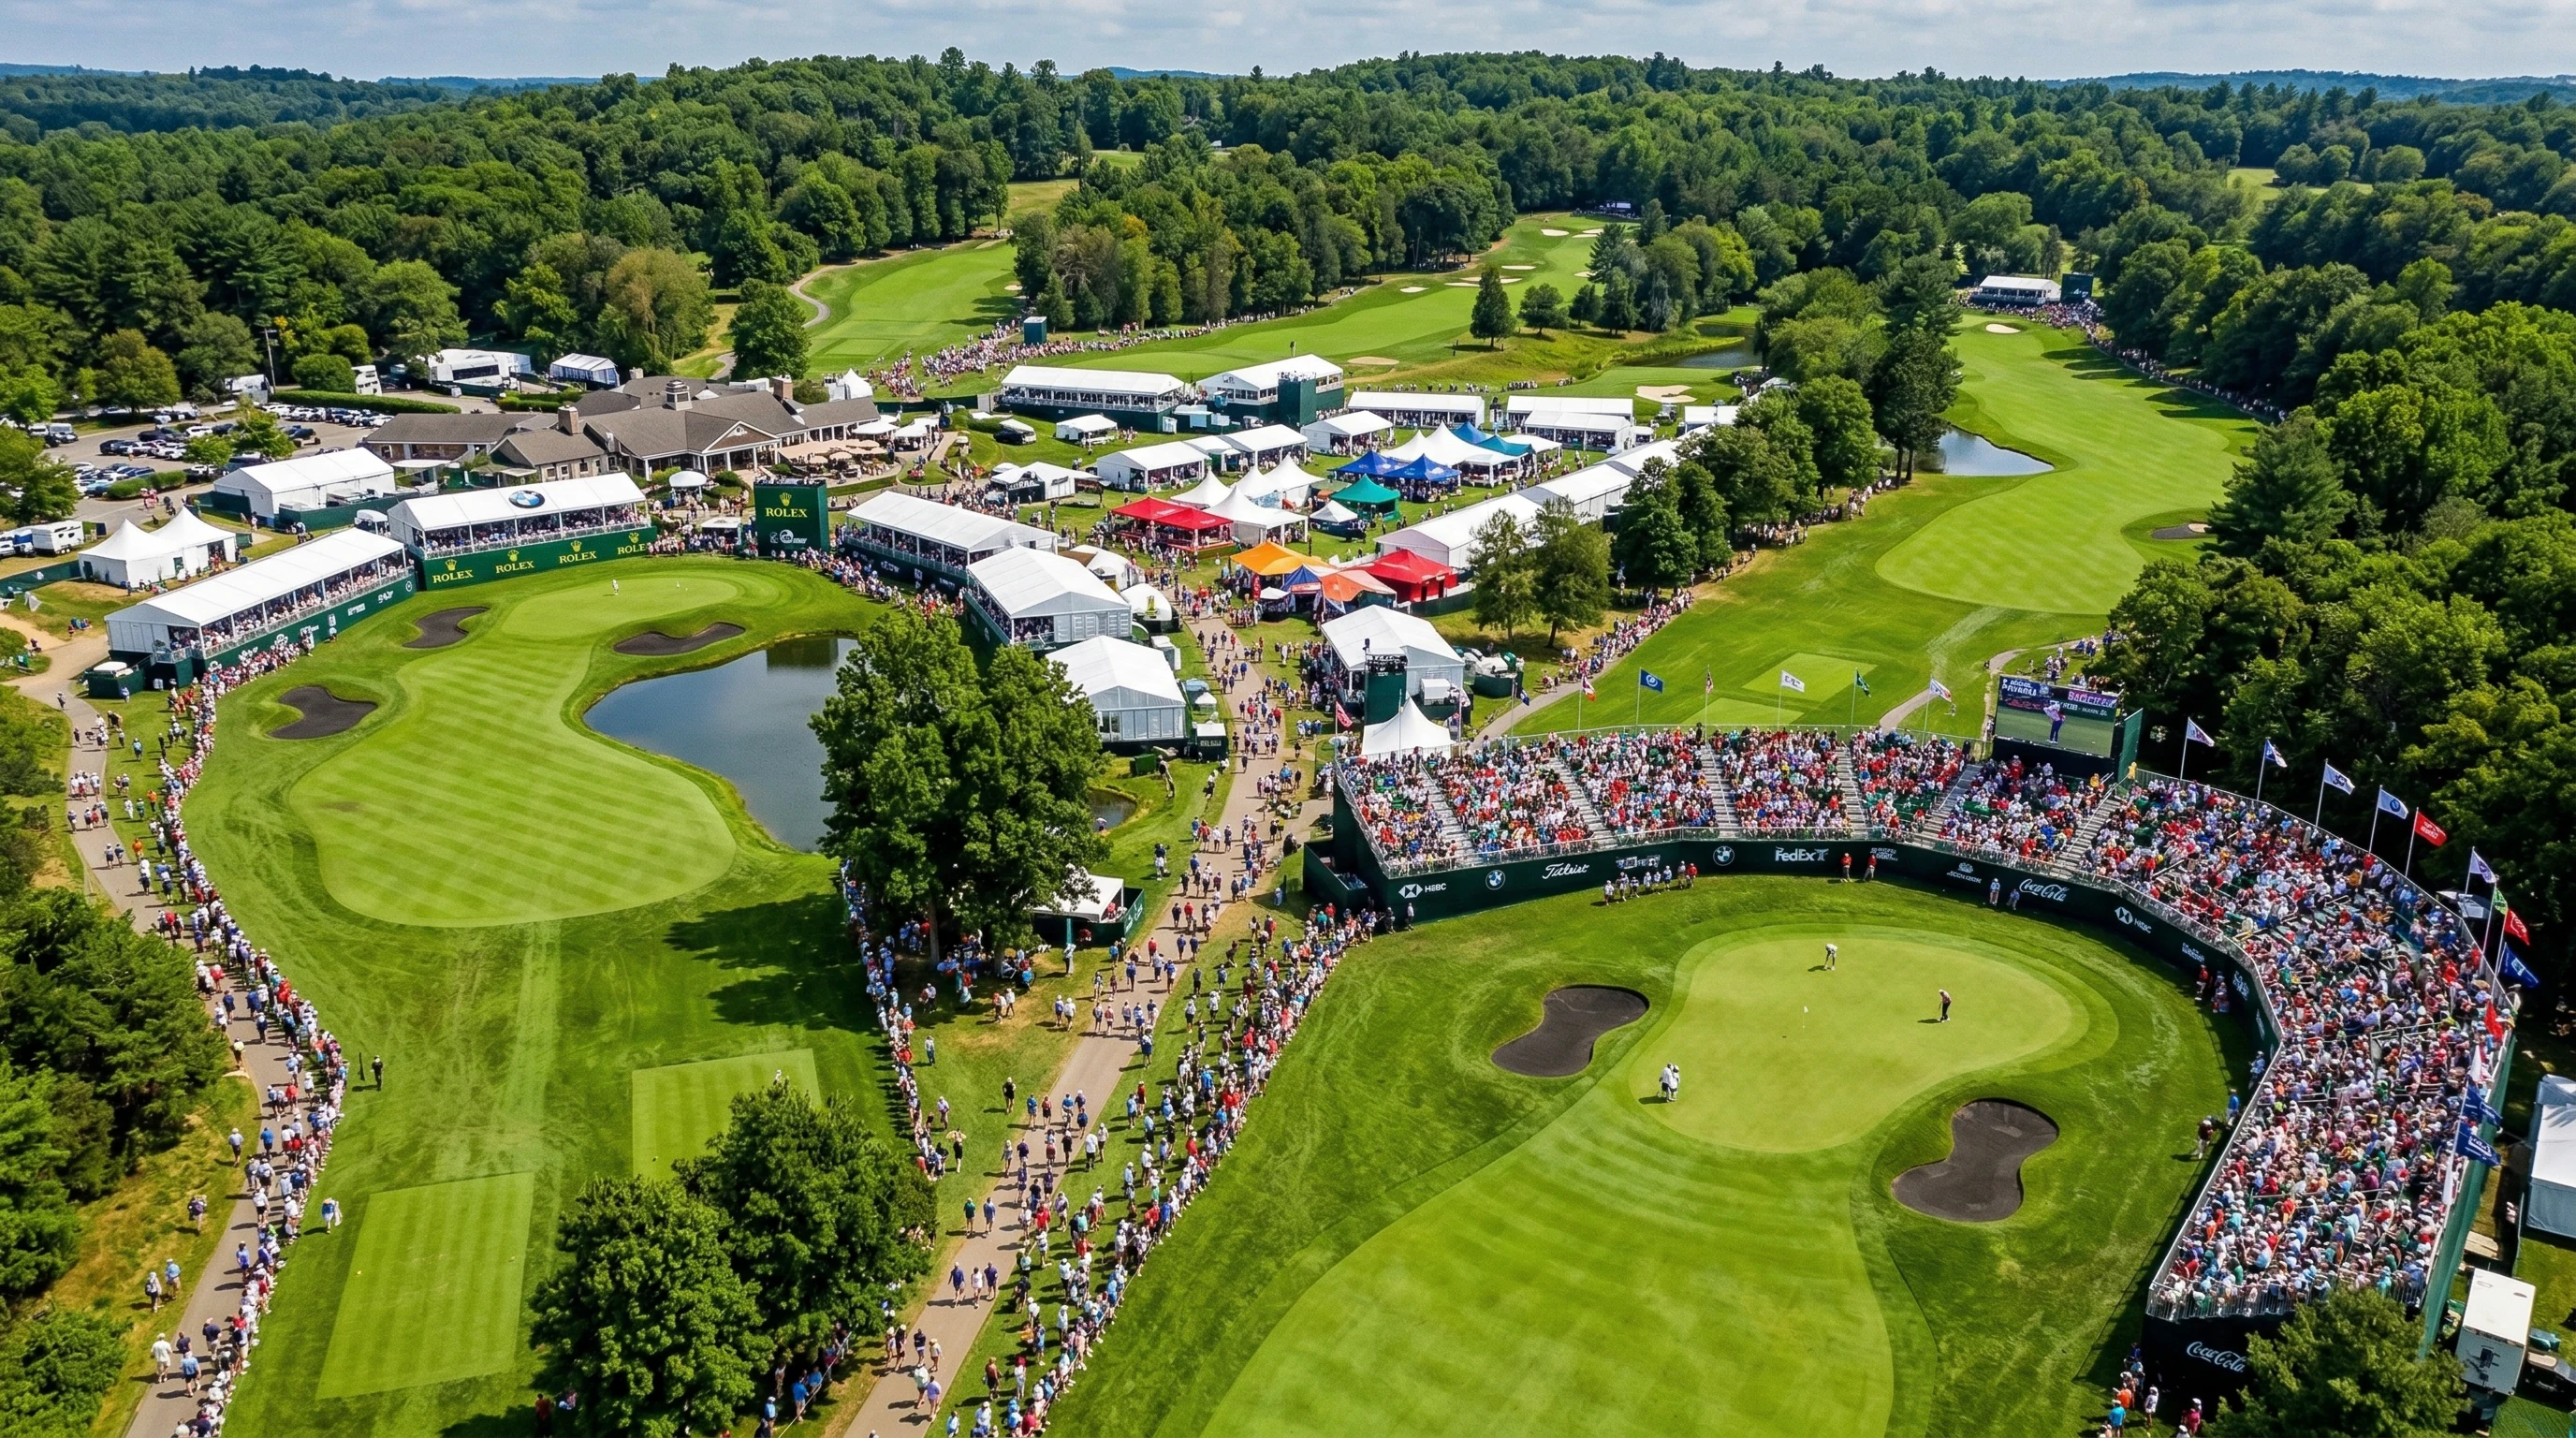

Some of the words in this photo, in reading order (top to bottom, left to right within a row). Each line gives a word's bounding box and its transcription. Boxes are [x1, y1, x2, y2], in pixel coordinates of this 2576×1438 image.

[765, 507, 808, 518] ROLEX
[617, 543, 646, 555] ROLE
[559, 550, 597, 564] ROLEX
[495, 561, 534, 574] ROLEX
[432, 569, 474, 583] ROLEX
